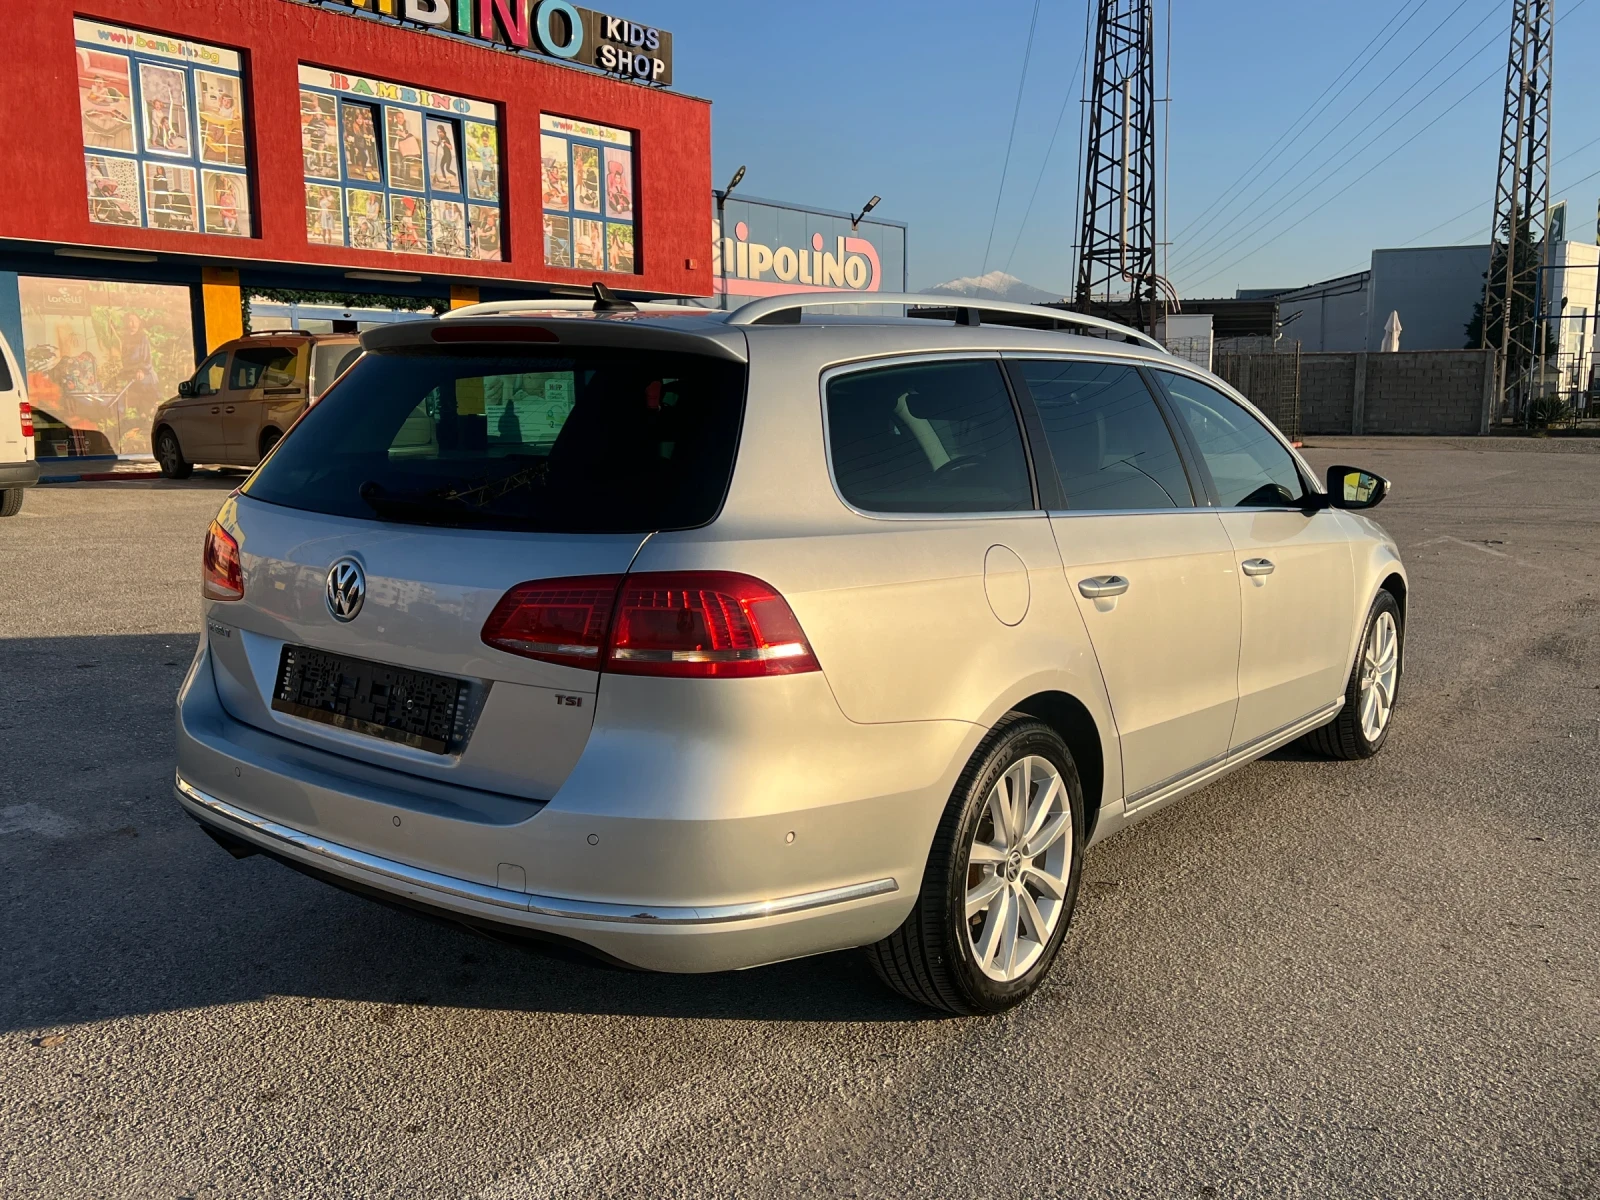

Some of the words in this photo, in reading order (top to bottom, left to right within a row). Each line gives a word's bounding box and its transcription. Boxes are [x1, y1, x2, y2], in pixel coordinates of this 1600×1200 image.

[605, 16, 659, 50] KIDS
[600, 44, 665, 80] SHOP
[329, 72, 471, 114] BAMBINO
[554, 693, 583, 708] TSI
